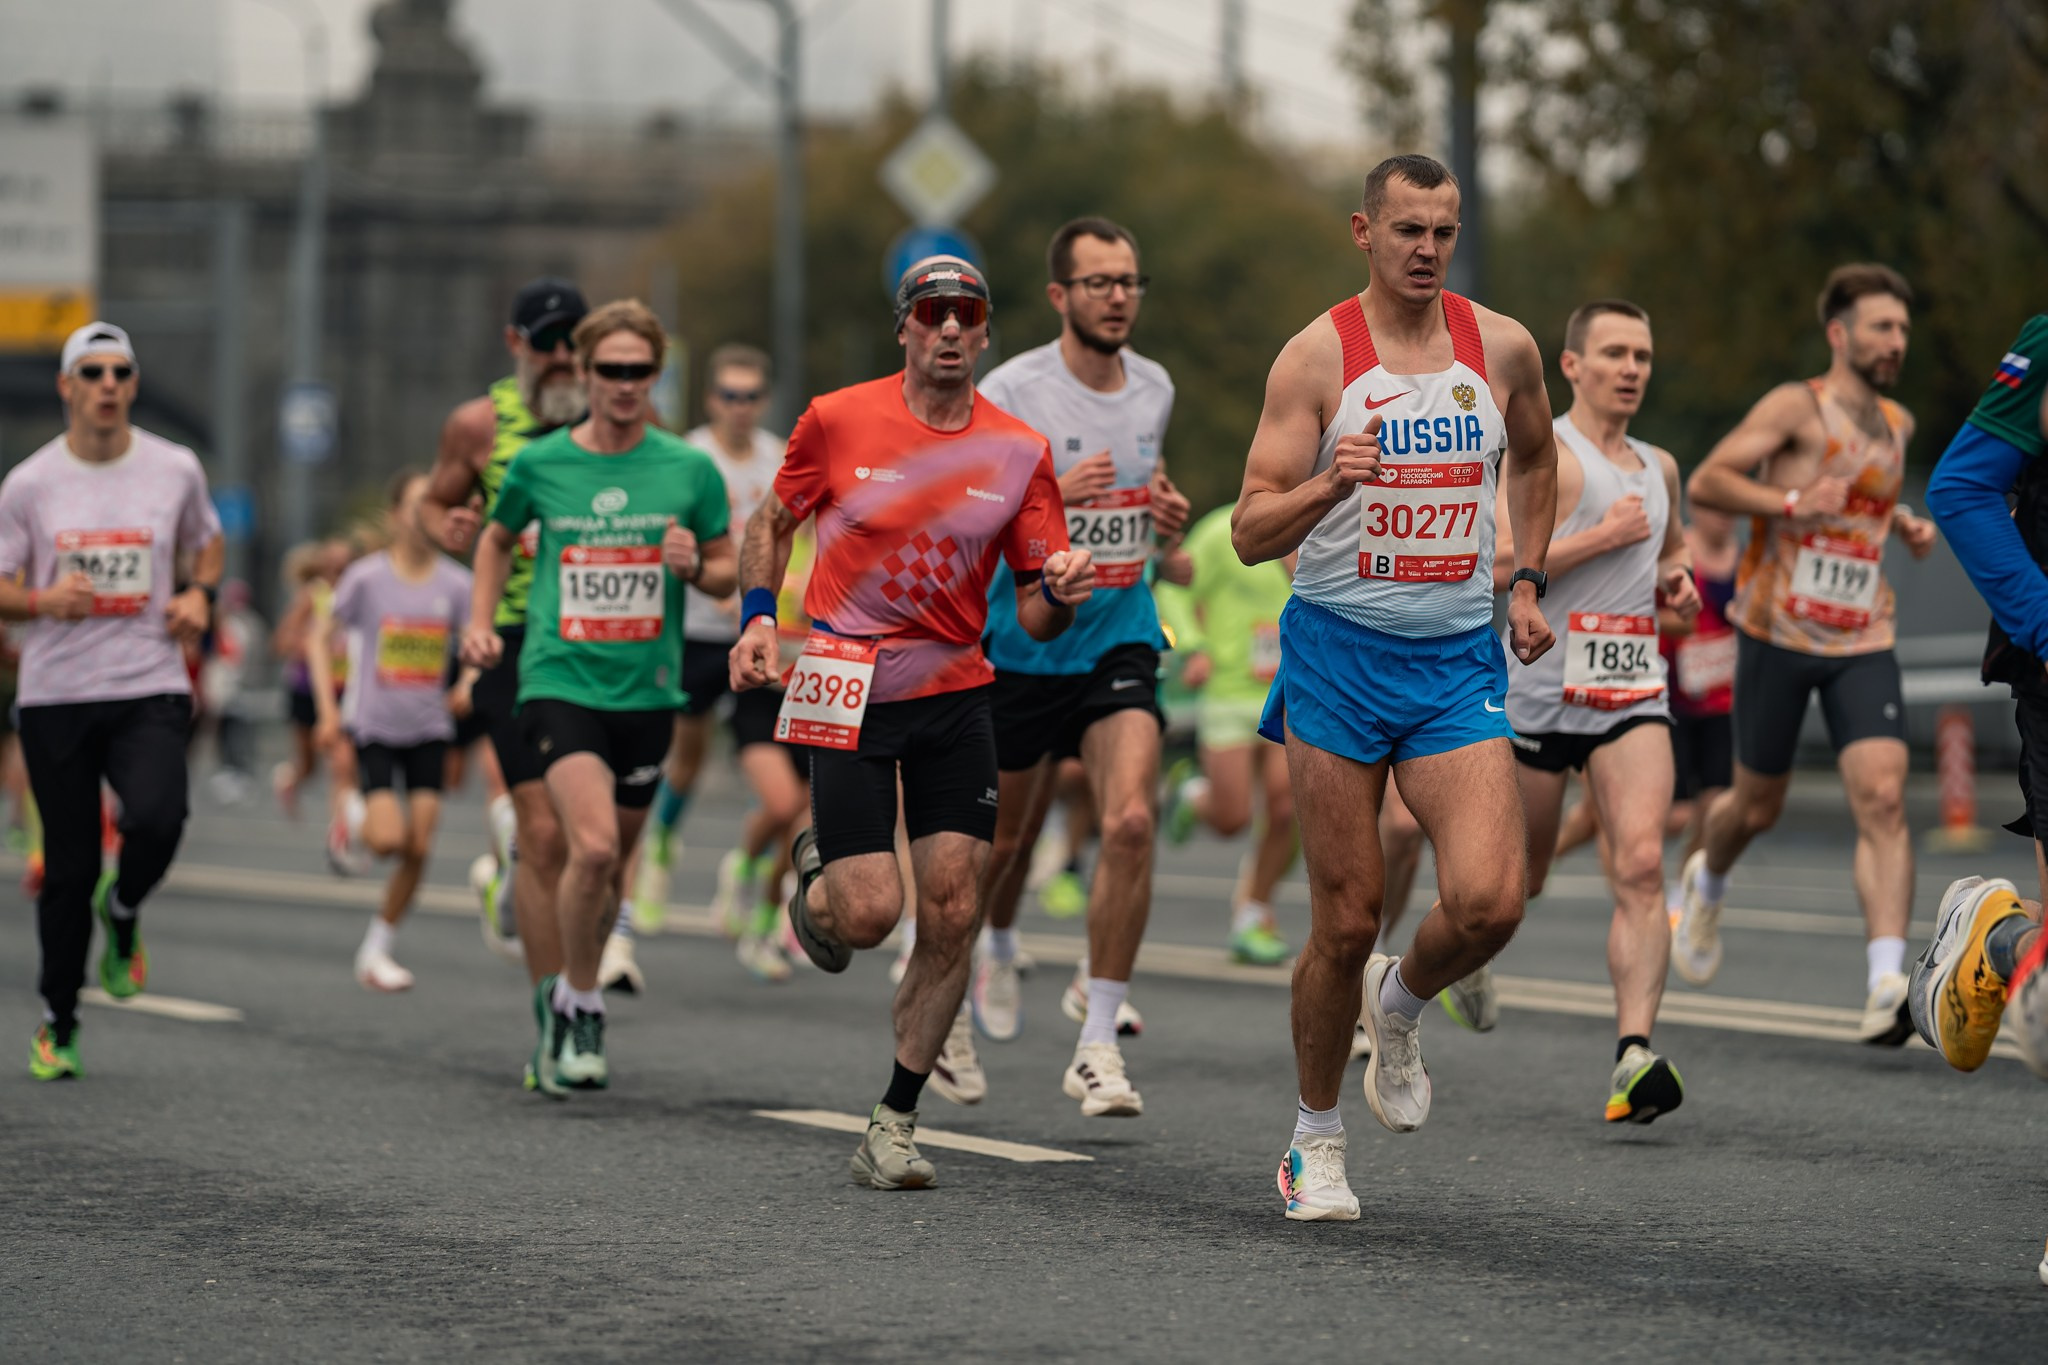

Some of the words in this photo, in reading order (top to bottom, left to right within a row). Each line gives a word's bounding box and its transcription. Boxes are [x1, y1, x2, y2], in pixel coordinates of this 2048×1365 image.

[1377, 415, 1483, 456] RUSSIA
[1367, 502, 1478, 538] 30277
[1375, 555, 1390, 574] B
[1813, 557, 1869, 592] 1199
[569, 571, 659, 600] 15079
[1584, 640, 1650, 672] 1834
[787, 670, 864, 711] 2398
